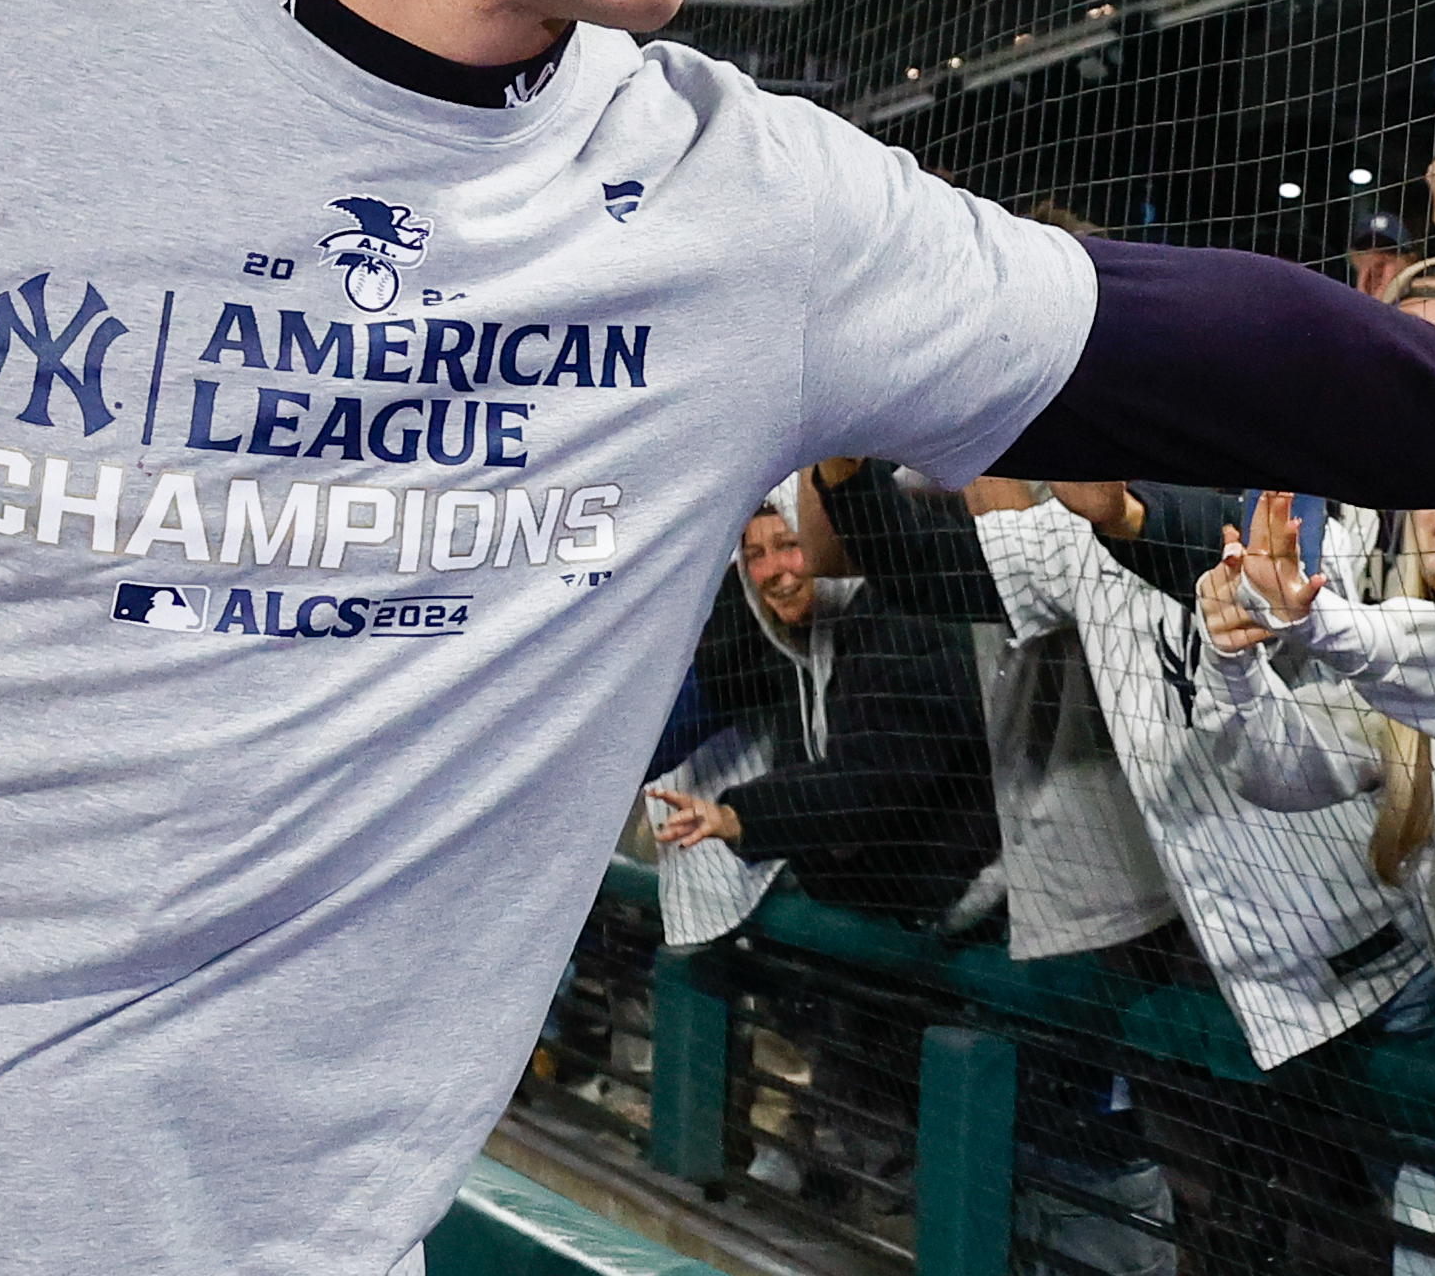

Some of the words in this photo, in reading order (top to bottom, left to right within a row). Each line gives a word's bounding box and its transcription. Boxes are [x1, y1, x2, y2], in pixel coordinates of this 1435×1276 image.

[243, 252, 295, 280] 20
[357, 238, 396, 258] A.L.
[197, 301, 652, 392] AMERICAN
[184, 378, 531, 468] LEAGUE
[213, 588, 372, 638] ALCS
[372, 605, 470, 628] 2024
